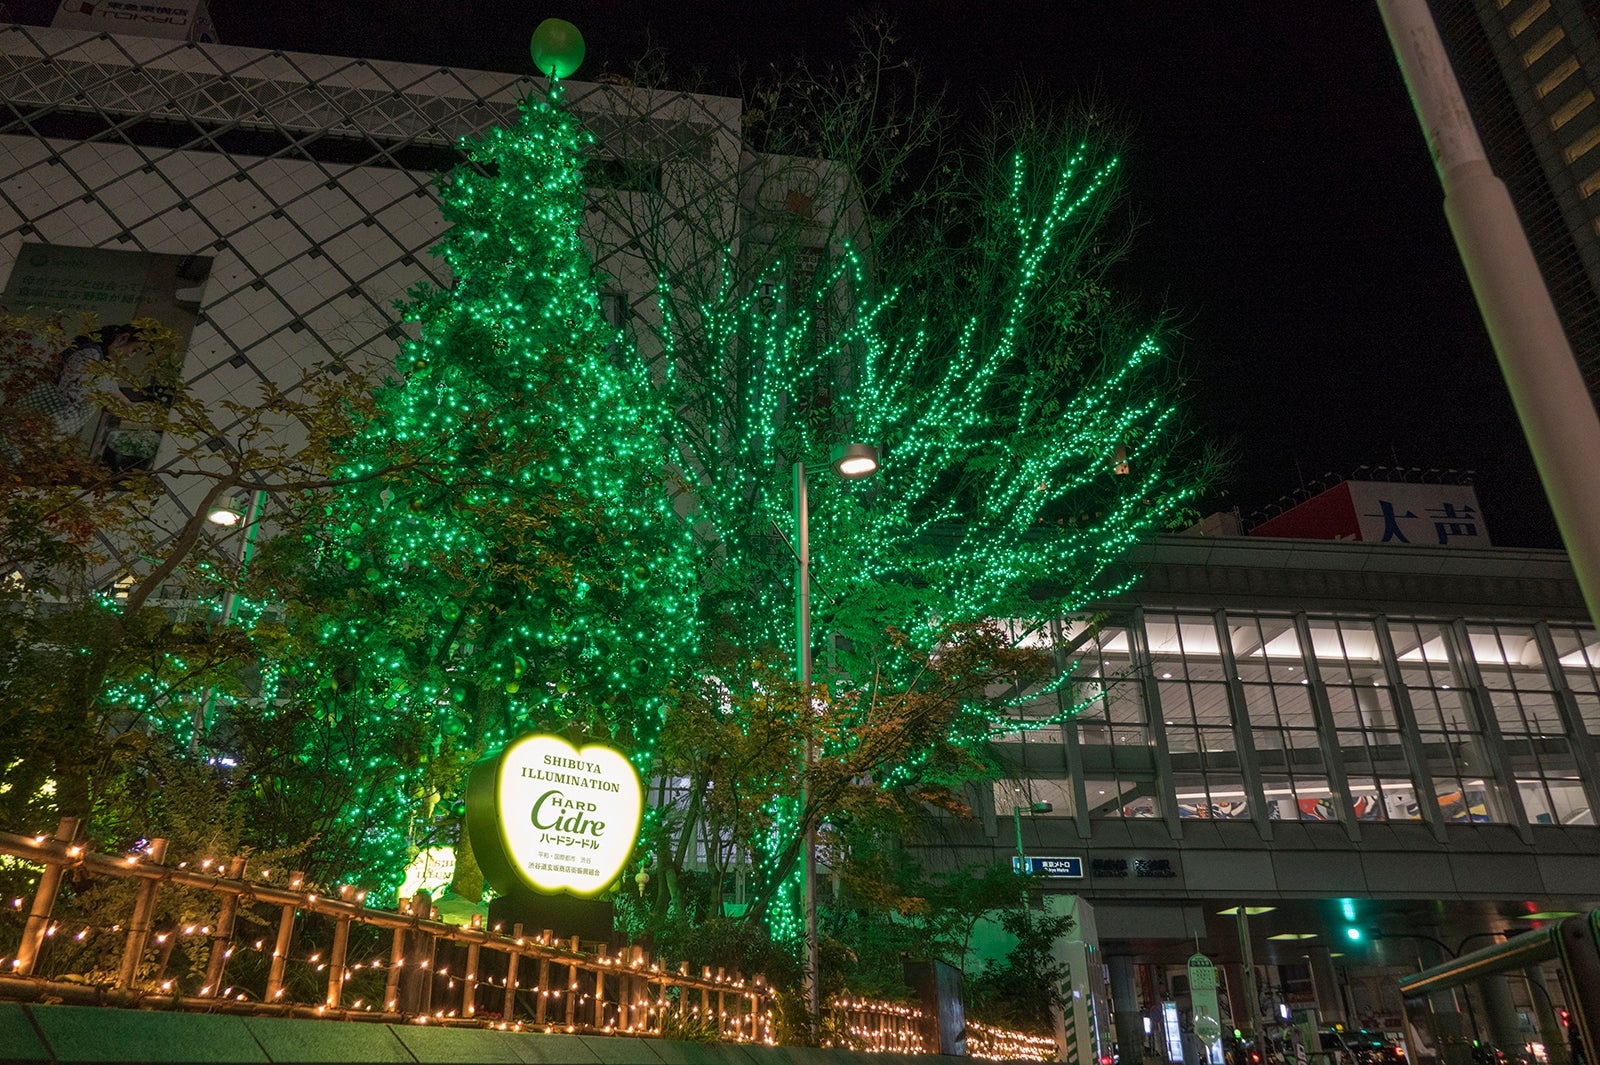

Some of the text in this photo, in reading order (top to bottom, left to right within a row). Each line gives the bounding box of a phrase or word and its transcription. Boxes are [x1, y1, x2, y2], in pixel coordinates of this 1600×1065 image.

[1363, 500, 1478, 545] 大声
[543, 754, 601, 774] SHIBUYA
[521, 767, 620, 793] ILLUMINATION
[530, 789, 606, 837] Cidre
[551, 797, 597, 812] HARD
[539, 833, 600, 850] ハードシードル
